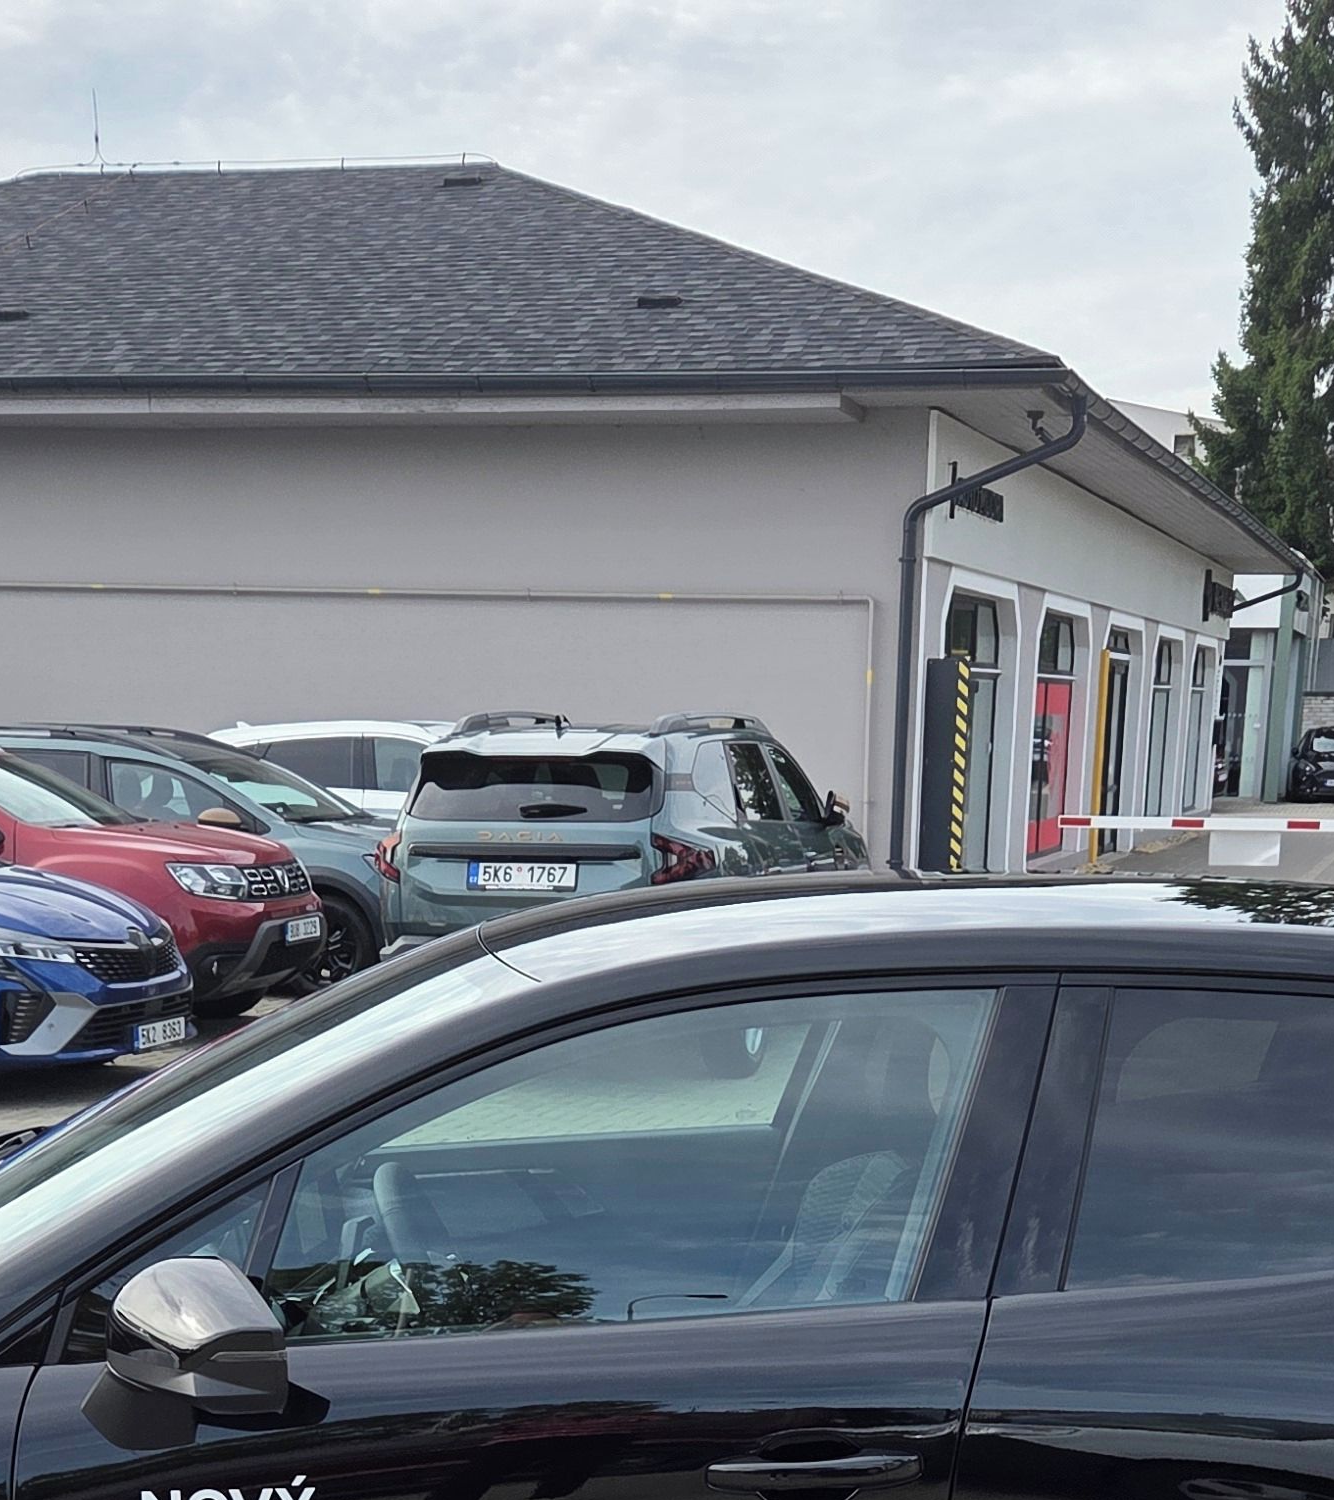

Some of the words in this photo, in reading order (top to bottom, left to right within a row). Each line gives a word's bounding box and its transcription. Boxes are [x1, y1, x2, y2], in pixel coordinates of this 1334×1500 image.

[477, 831, 564, 842] DACIA
[482, 866, 513, 883] 5K6
[527, 866, 568, 884] 1767
